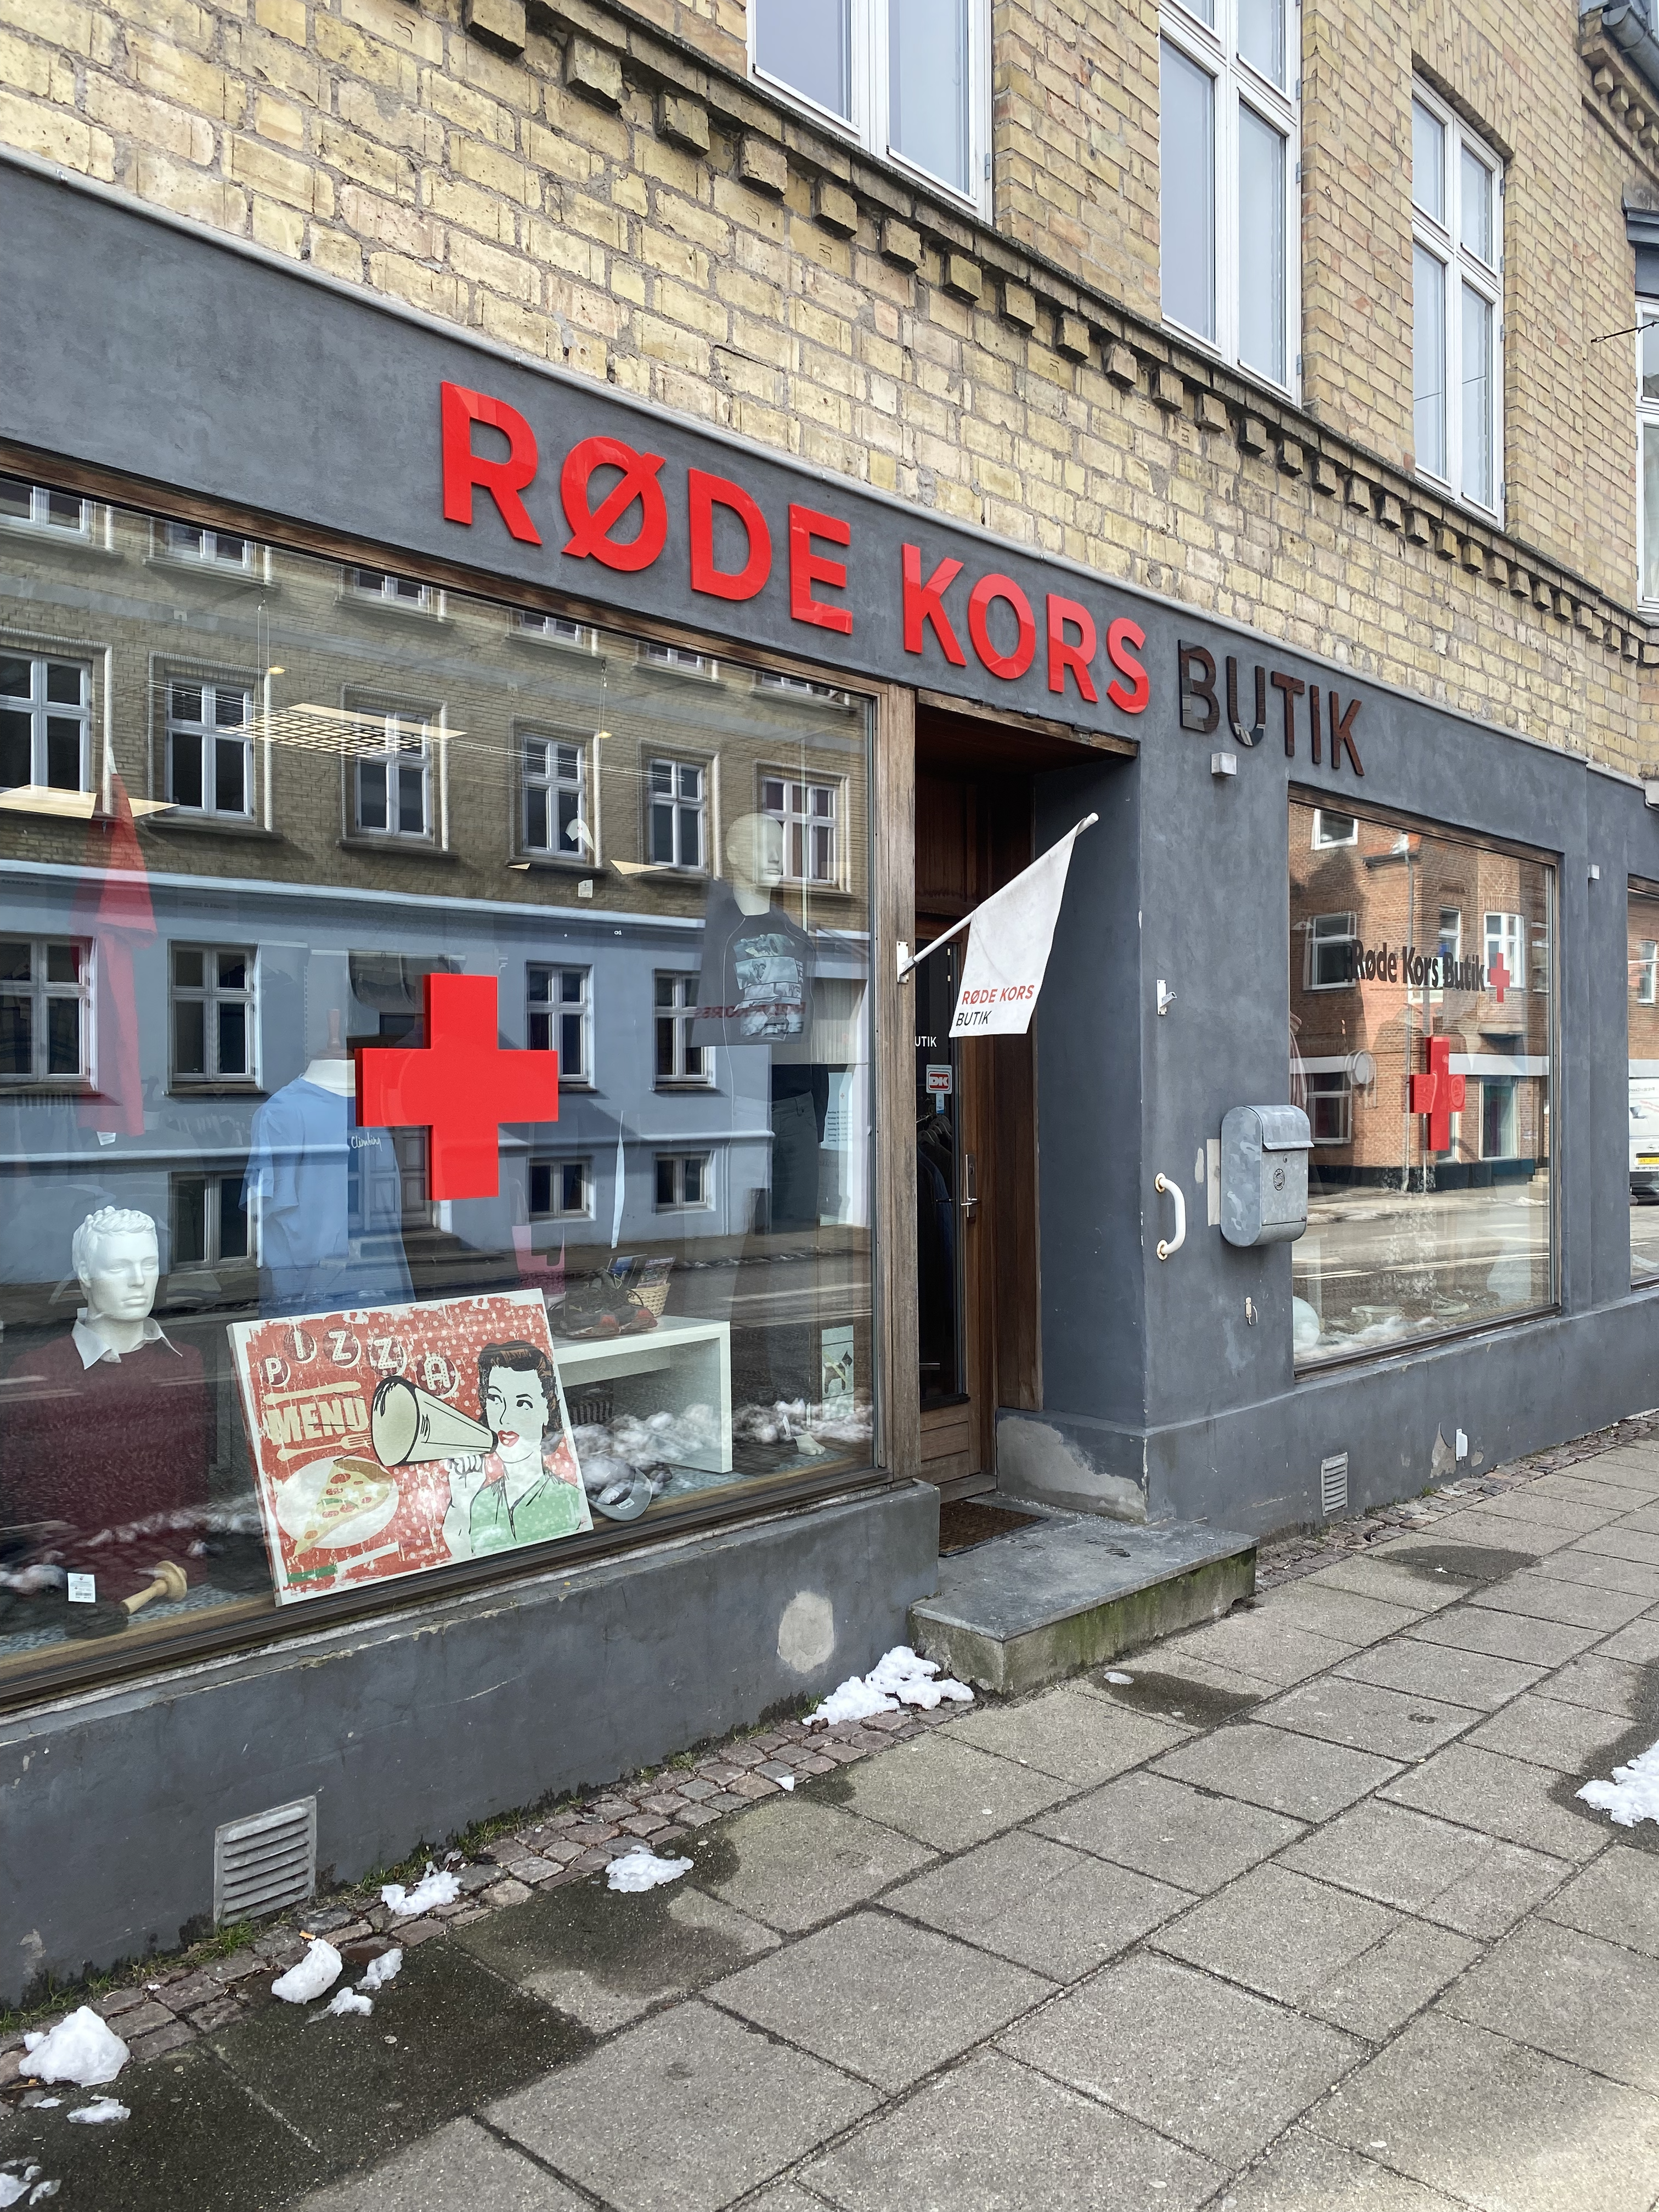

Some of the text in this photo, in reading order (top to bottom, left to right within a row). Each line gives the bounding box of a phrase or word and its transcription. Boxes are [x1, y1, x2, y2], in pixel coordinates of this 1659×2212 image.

[441, 381, 1365, 776] RØDE KORS BUTIK
[1351, 939, 1486, 992] Røde Kors Butik
[962, 985, 1035, 1005] RØDE KORS
[956, 1011, 992, 1027] BUTIK
[915, 1036, 937, 1047] UTIK
[351, 1132, 383, 1152] Climbing
[266, 1329, 451, 1391] PIZZA
[264, 1395, 370, 1446] MENU
